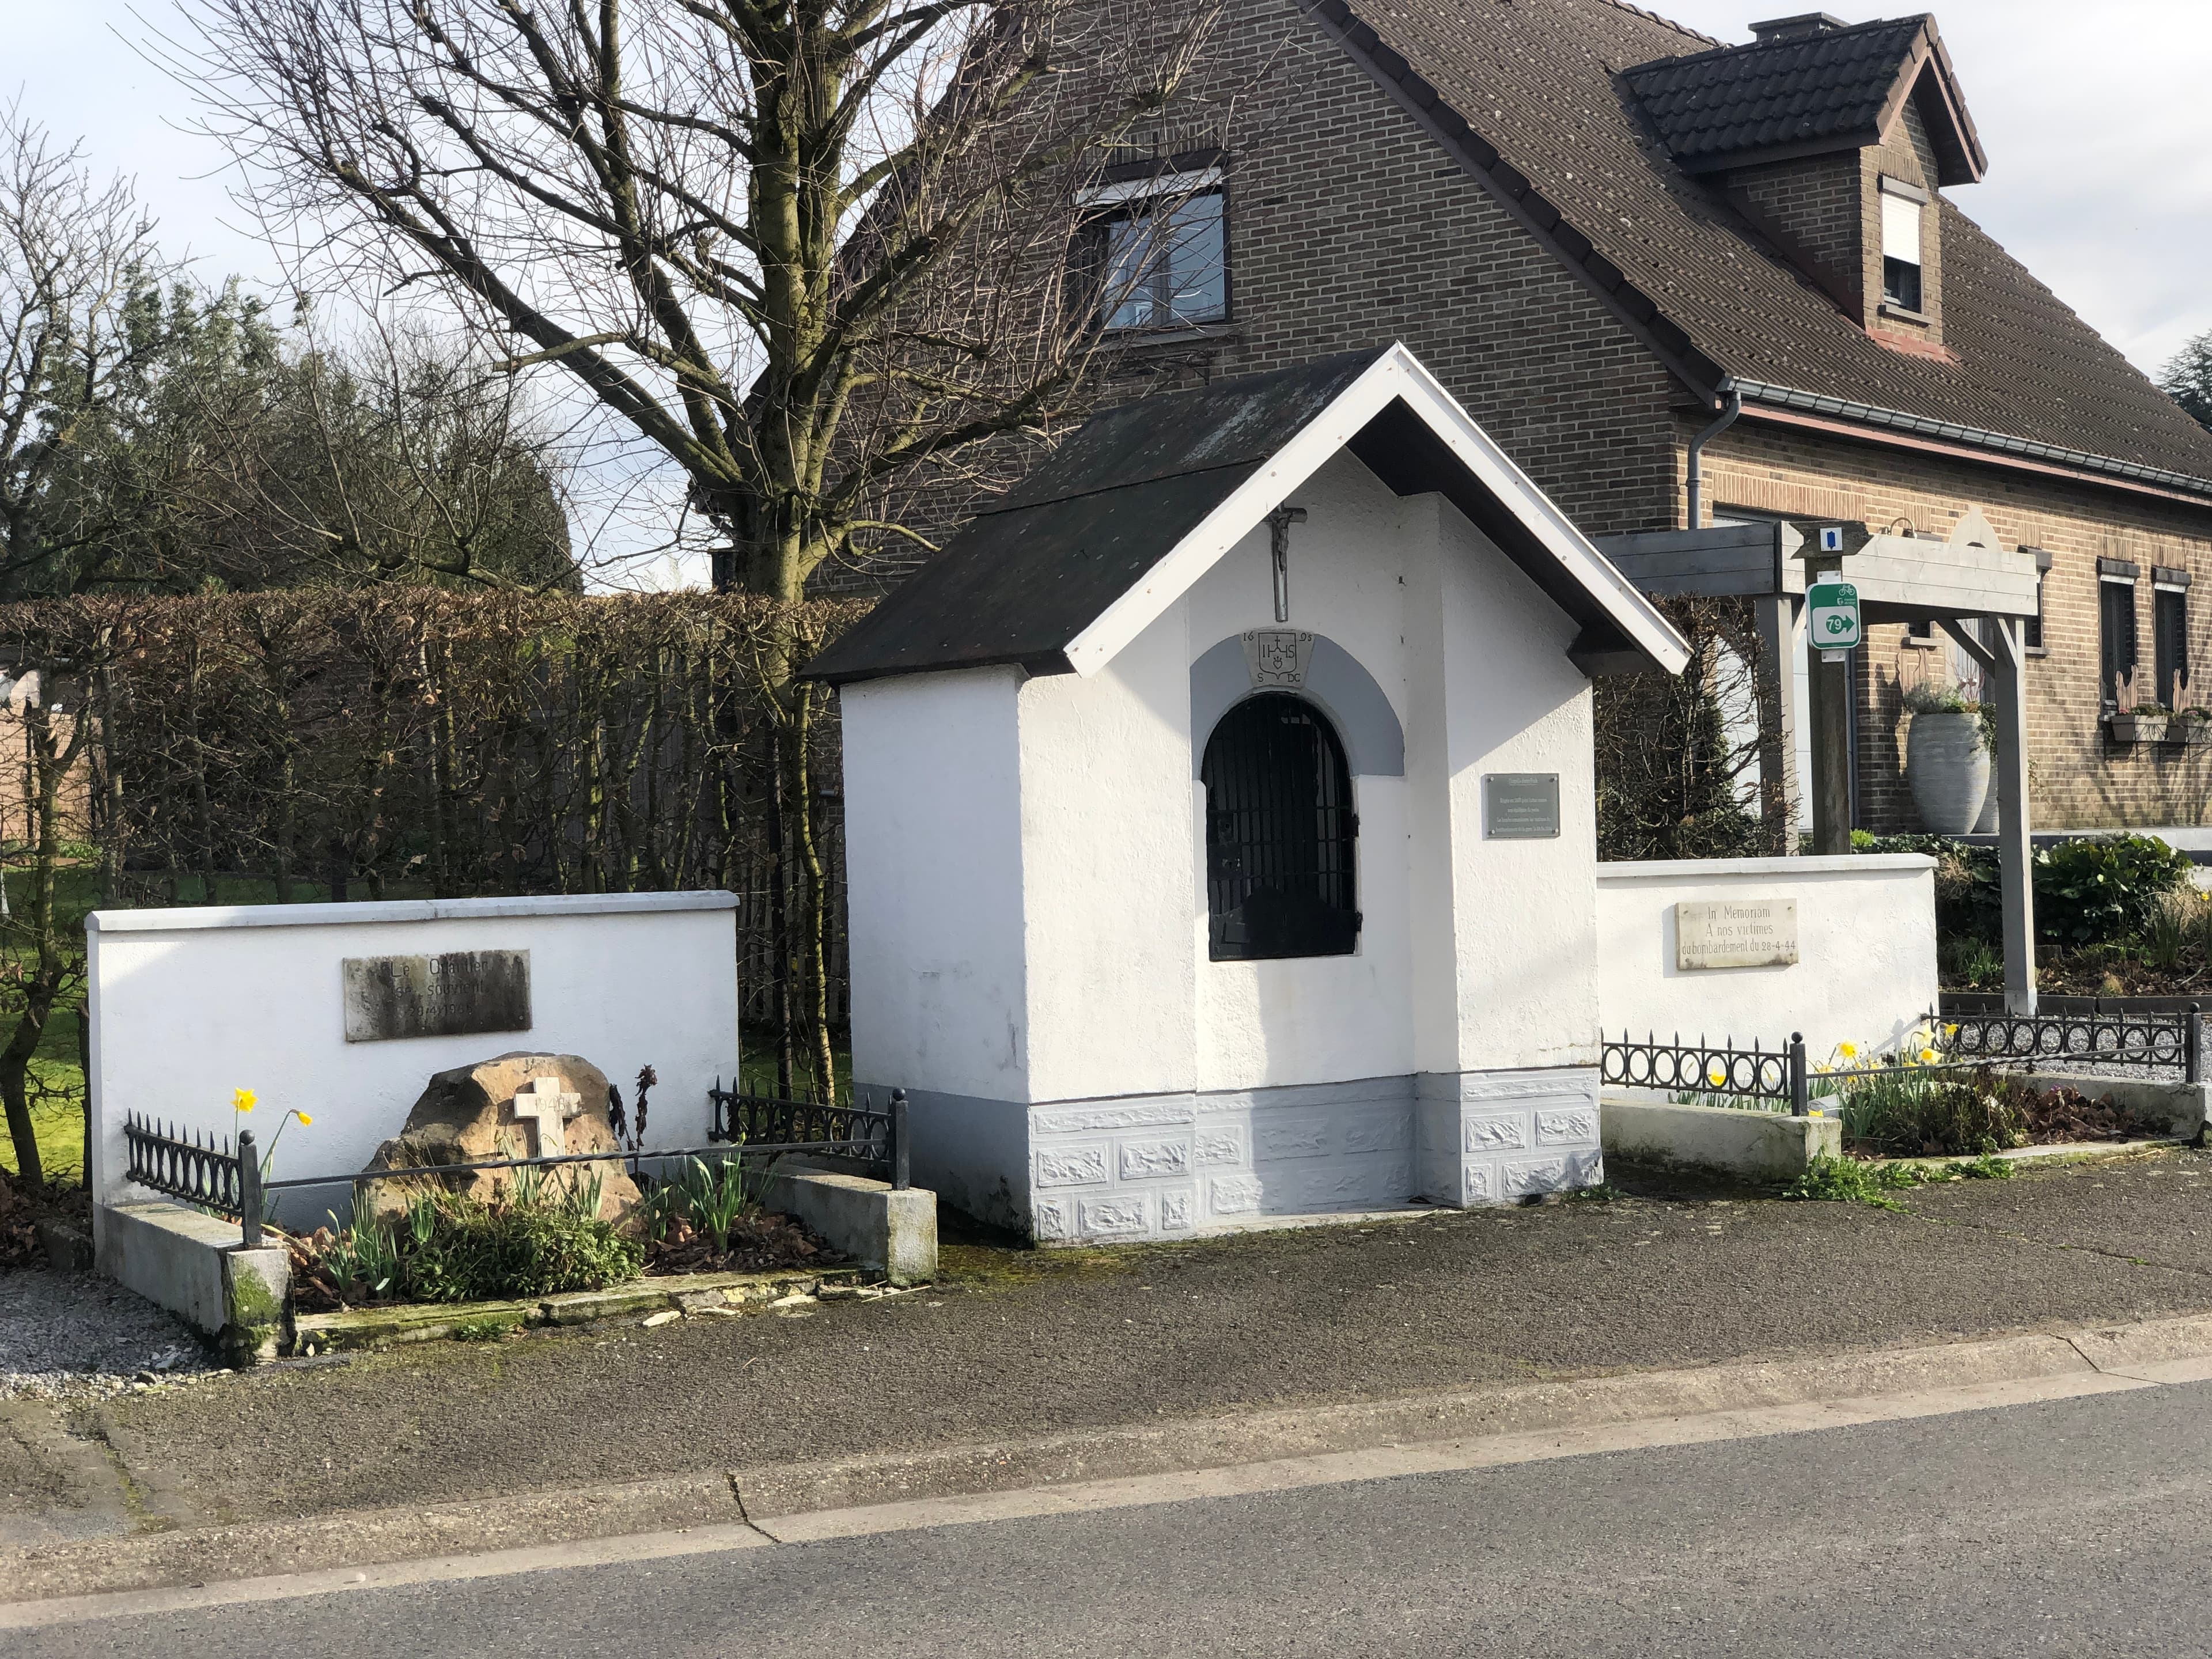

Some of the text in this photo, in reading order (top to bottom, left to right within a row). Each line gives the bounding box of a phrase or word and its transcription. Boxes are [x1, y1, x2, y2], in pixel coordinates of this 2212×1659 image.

[1827, 619, 1842, 630] 79
[1243, 631, 1254, 641] 16
[1257, 673, 1300, 682] S DC
[1707, 906, 1770, 920] In Memoriam
[1706, 922, 1774, 937] A nos victimes
[1682, 942, 1691, 955] du
[1692, 940, 1748, 955] bombardement
[1750, 940, 1759, 952] du
[391, 958, 488, 978] Le Quartier
